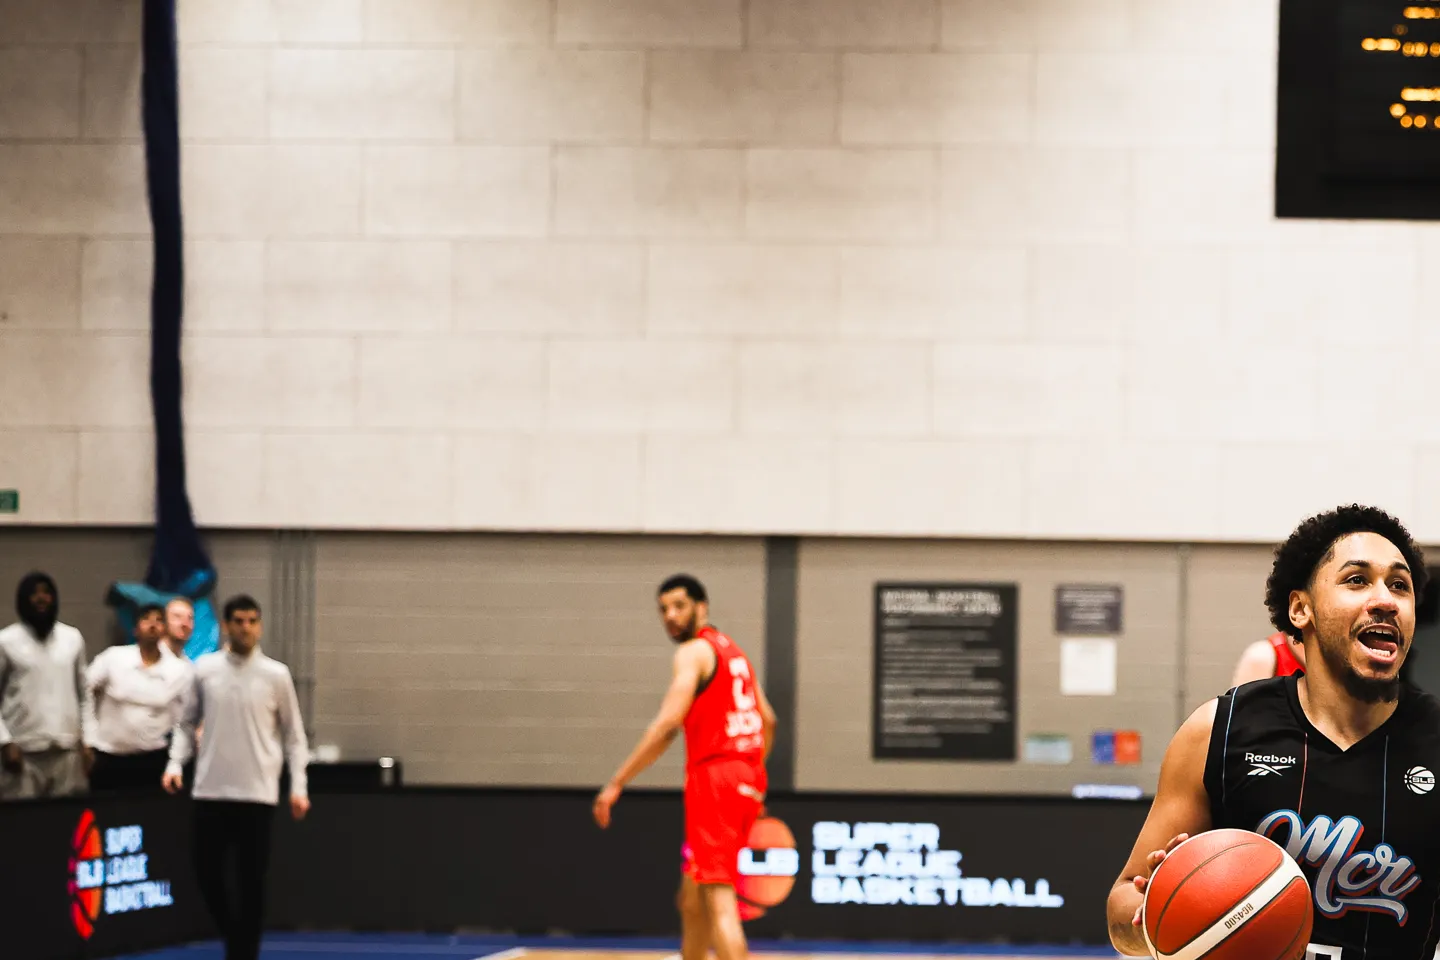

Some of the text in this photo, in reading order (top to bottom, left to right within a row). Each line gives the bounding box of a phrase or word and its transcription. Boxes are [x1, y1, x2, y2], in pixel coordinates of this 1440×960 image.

[1244, 752, 1297, 765] Reebok
[812, 849, 963, 878] LEAGUE
[1255, 808, 1422, 926] Mcr
[811, 875, 1064, 907] BASKETBALL
